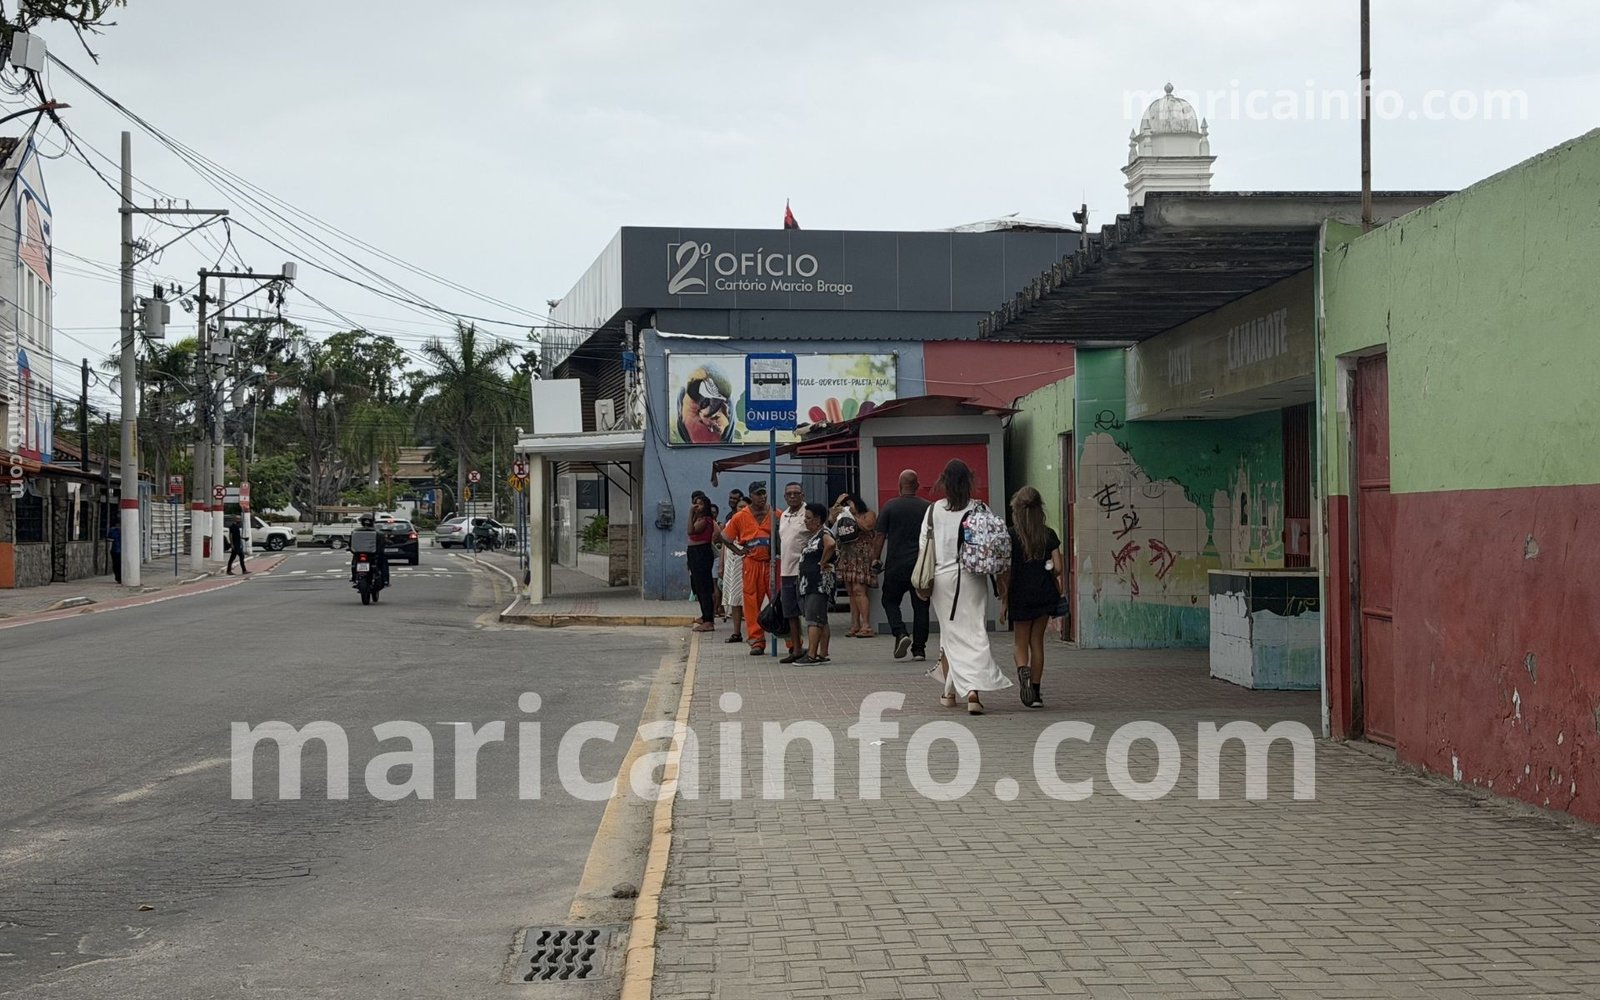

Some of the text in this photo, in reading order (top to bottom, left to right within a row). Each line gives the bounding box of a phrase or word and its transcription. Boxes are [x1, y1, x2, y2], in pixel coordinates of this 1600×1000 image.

[714, 247, 819, 277] OFÍCIO
[715, 277, 853, 296] Cartório Marcio Braga
[1228, 307, 1288, 371] CAMAROTE
[1168, 345, 1192, 386] PISTA
[746, 407, 797, 421] ÔNIBUS
